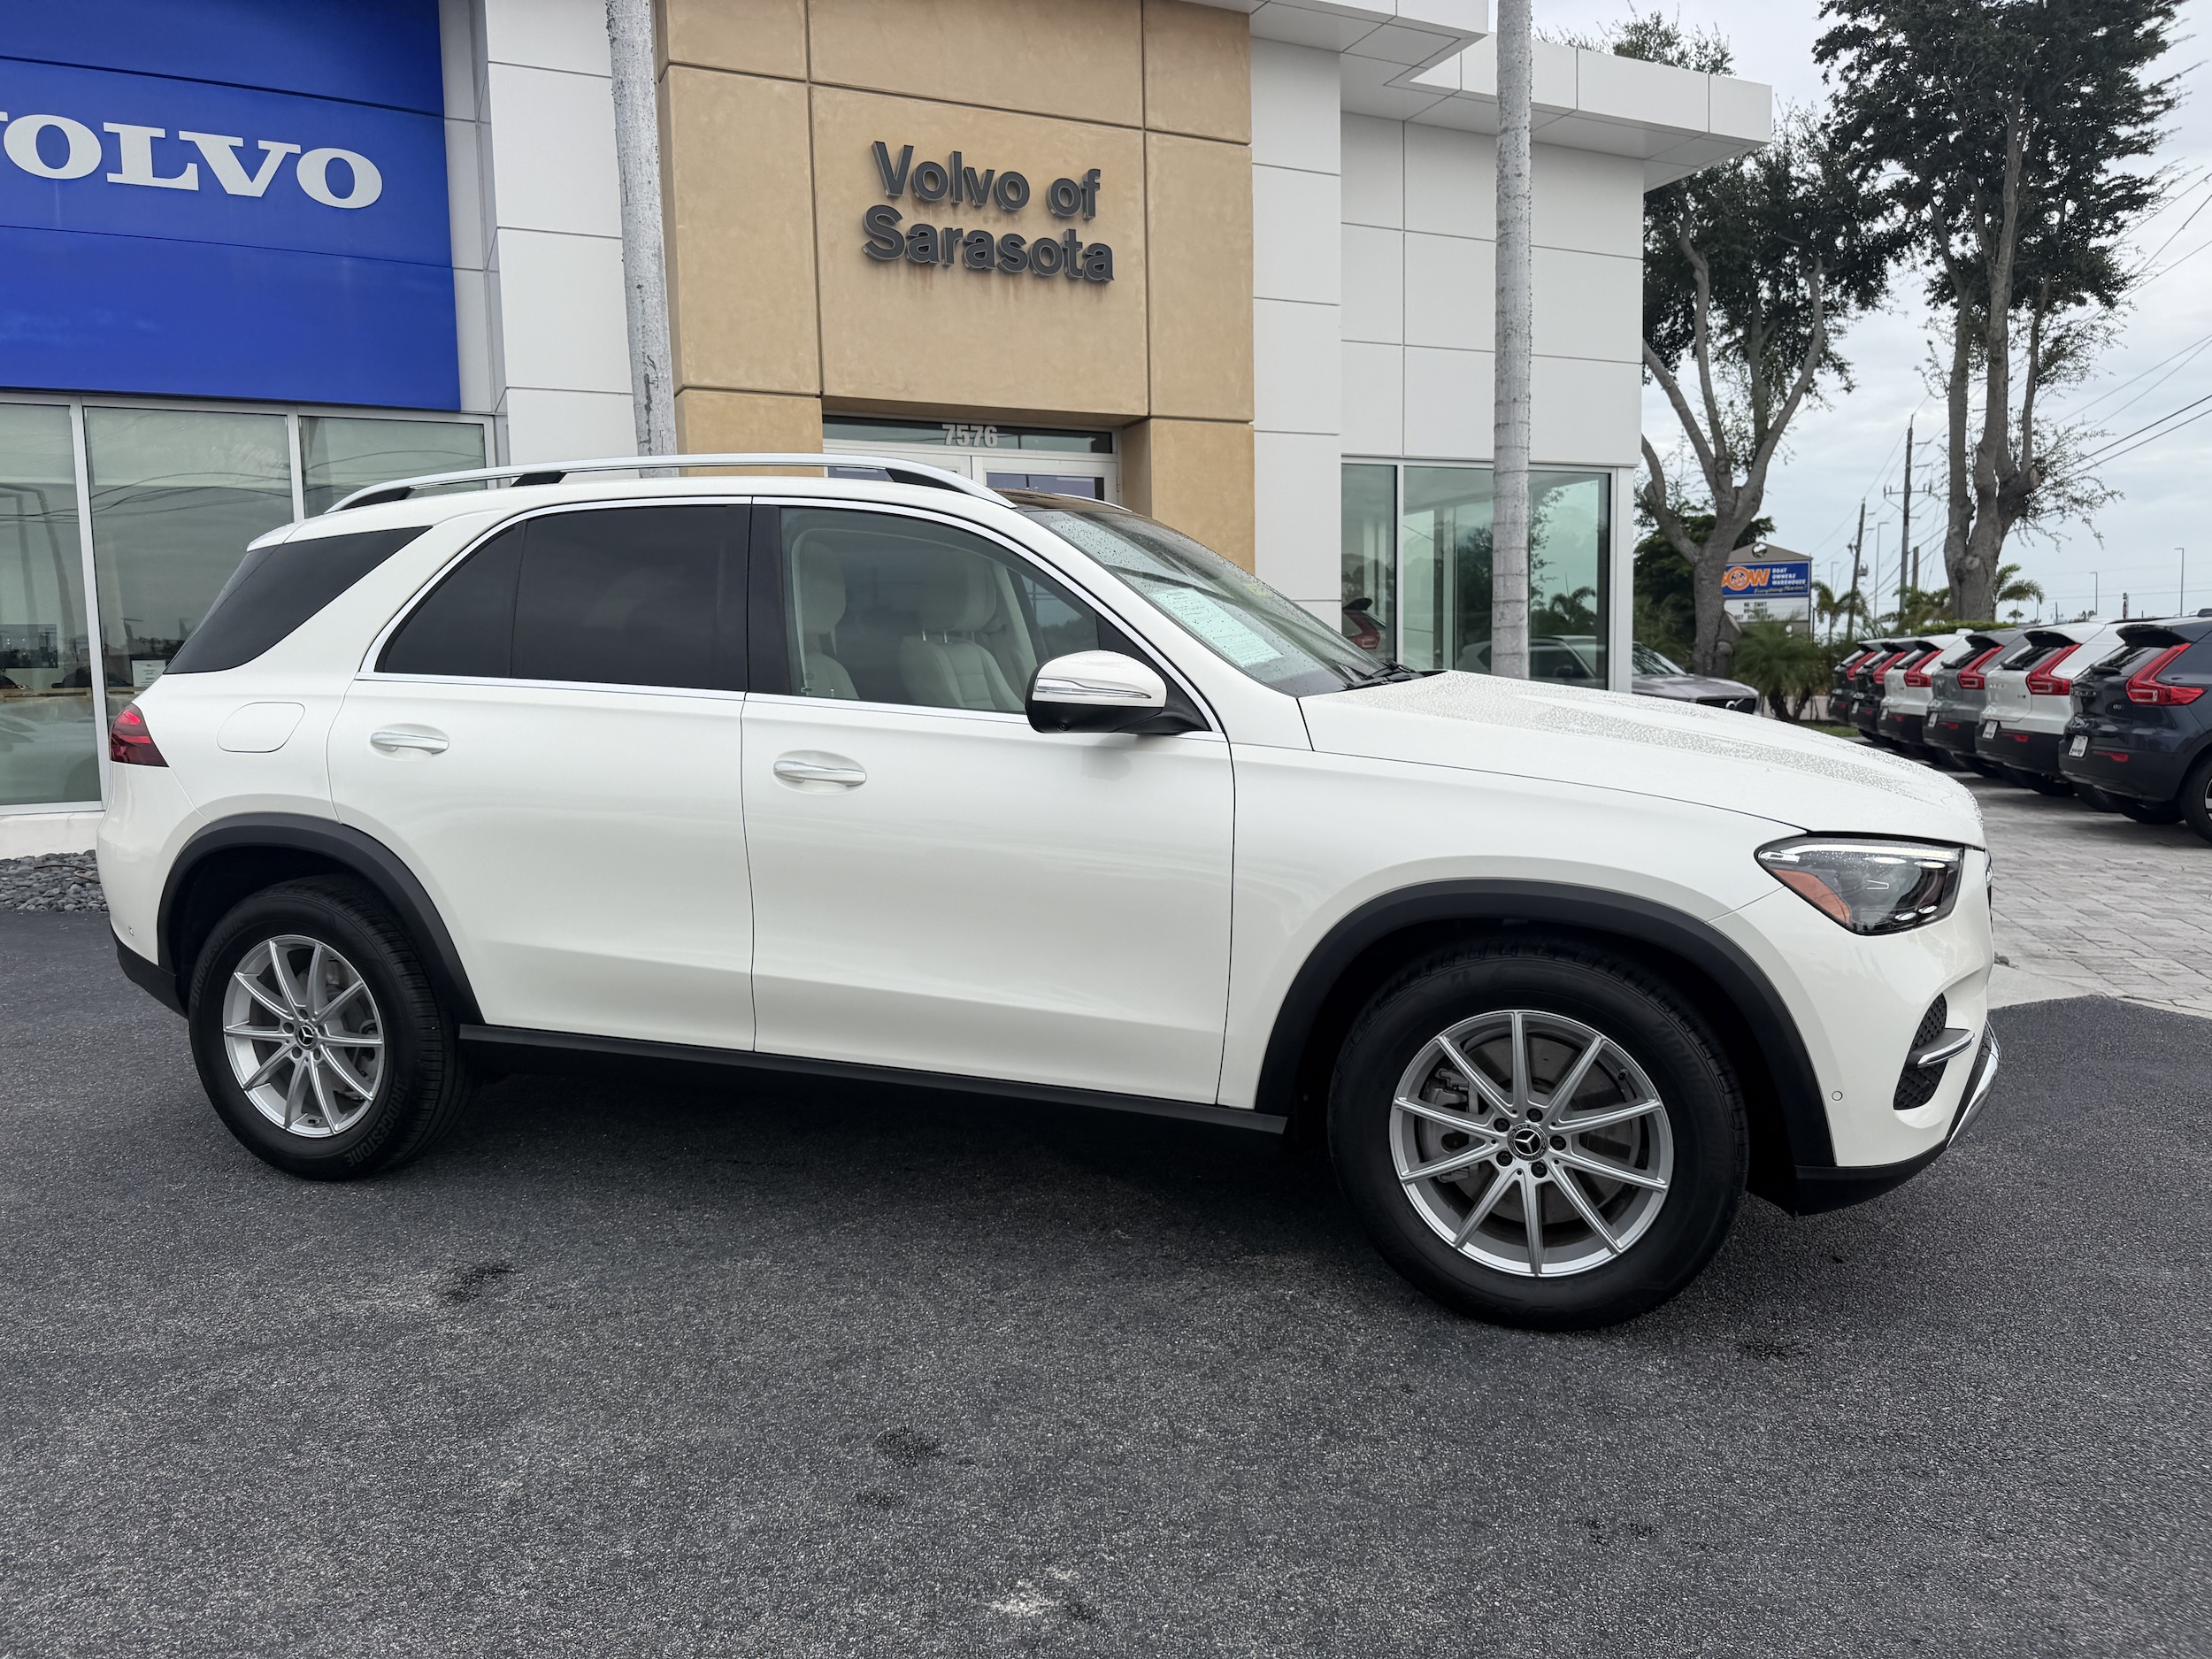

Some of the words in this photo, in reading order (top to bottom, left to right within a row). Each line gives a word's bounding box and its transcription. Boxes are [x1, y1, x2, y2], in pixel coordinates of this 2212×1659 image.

[0, 111, 383, 210] OLVO
[872, 140, 1030, 211] Volvo
[1046, 168, 1101, 221] of
[862, 204, 1114, 283] Sarasota
[941, 424, 998, 448] 7576
[344, 1073, 409, 1168] BRIDGESTONE
